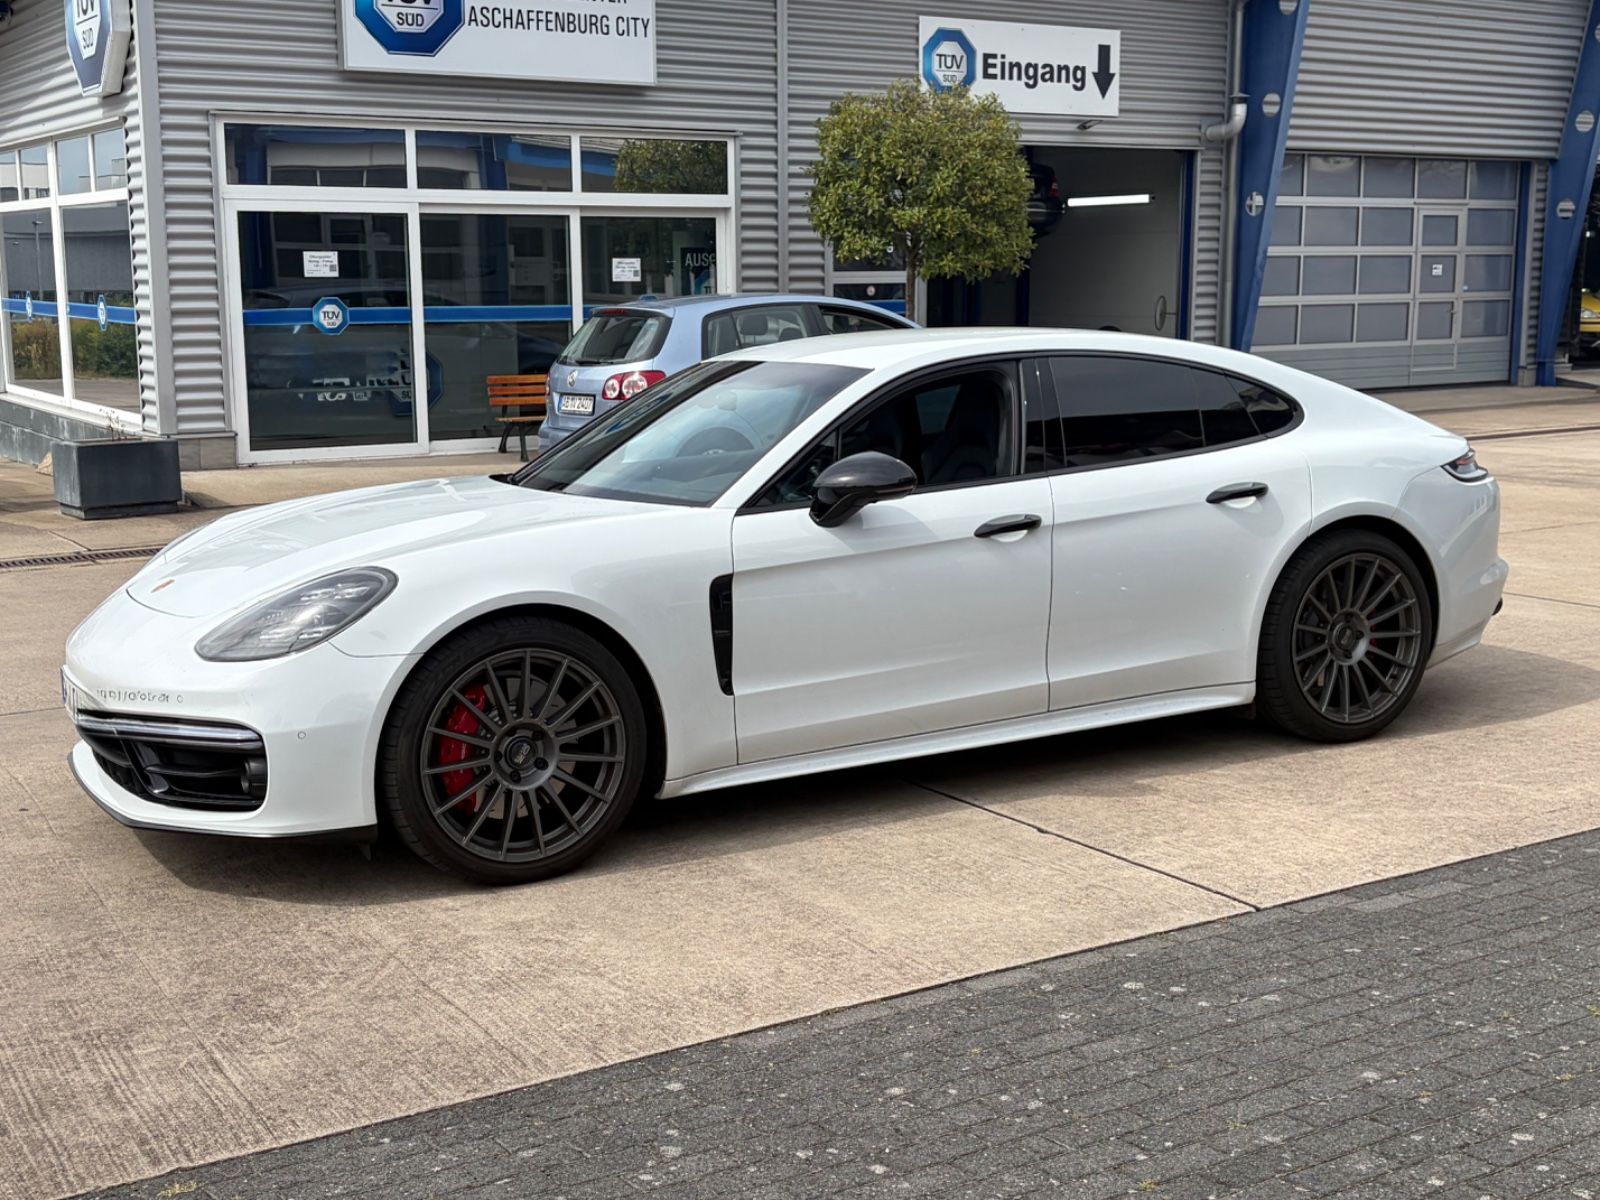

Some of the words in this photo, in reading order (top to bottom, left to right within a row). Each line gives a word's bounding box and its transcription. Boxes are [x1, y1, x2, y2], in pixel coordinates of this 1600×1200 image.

[396, 12, 425, 27] SÜD
[468, 6, 610, 36] ASCHAFFENBURG
[616, 16, 650, 38] CITY
[936, 53, 965, 69] TÜV
[982, 52, 1087, 91] Eingang
[322, 311, 340, 320] TÜV
